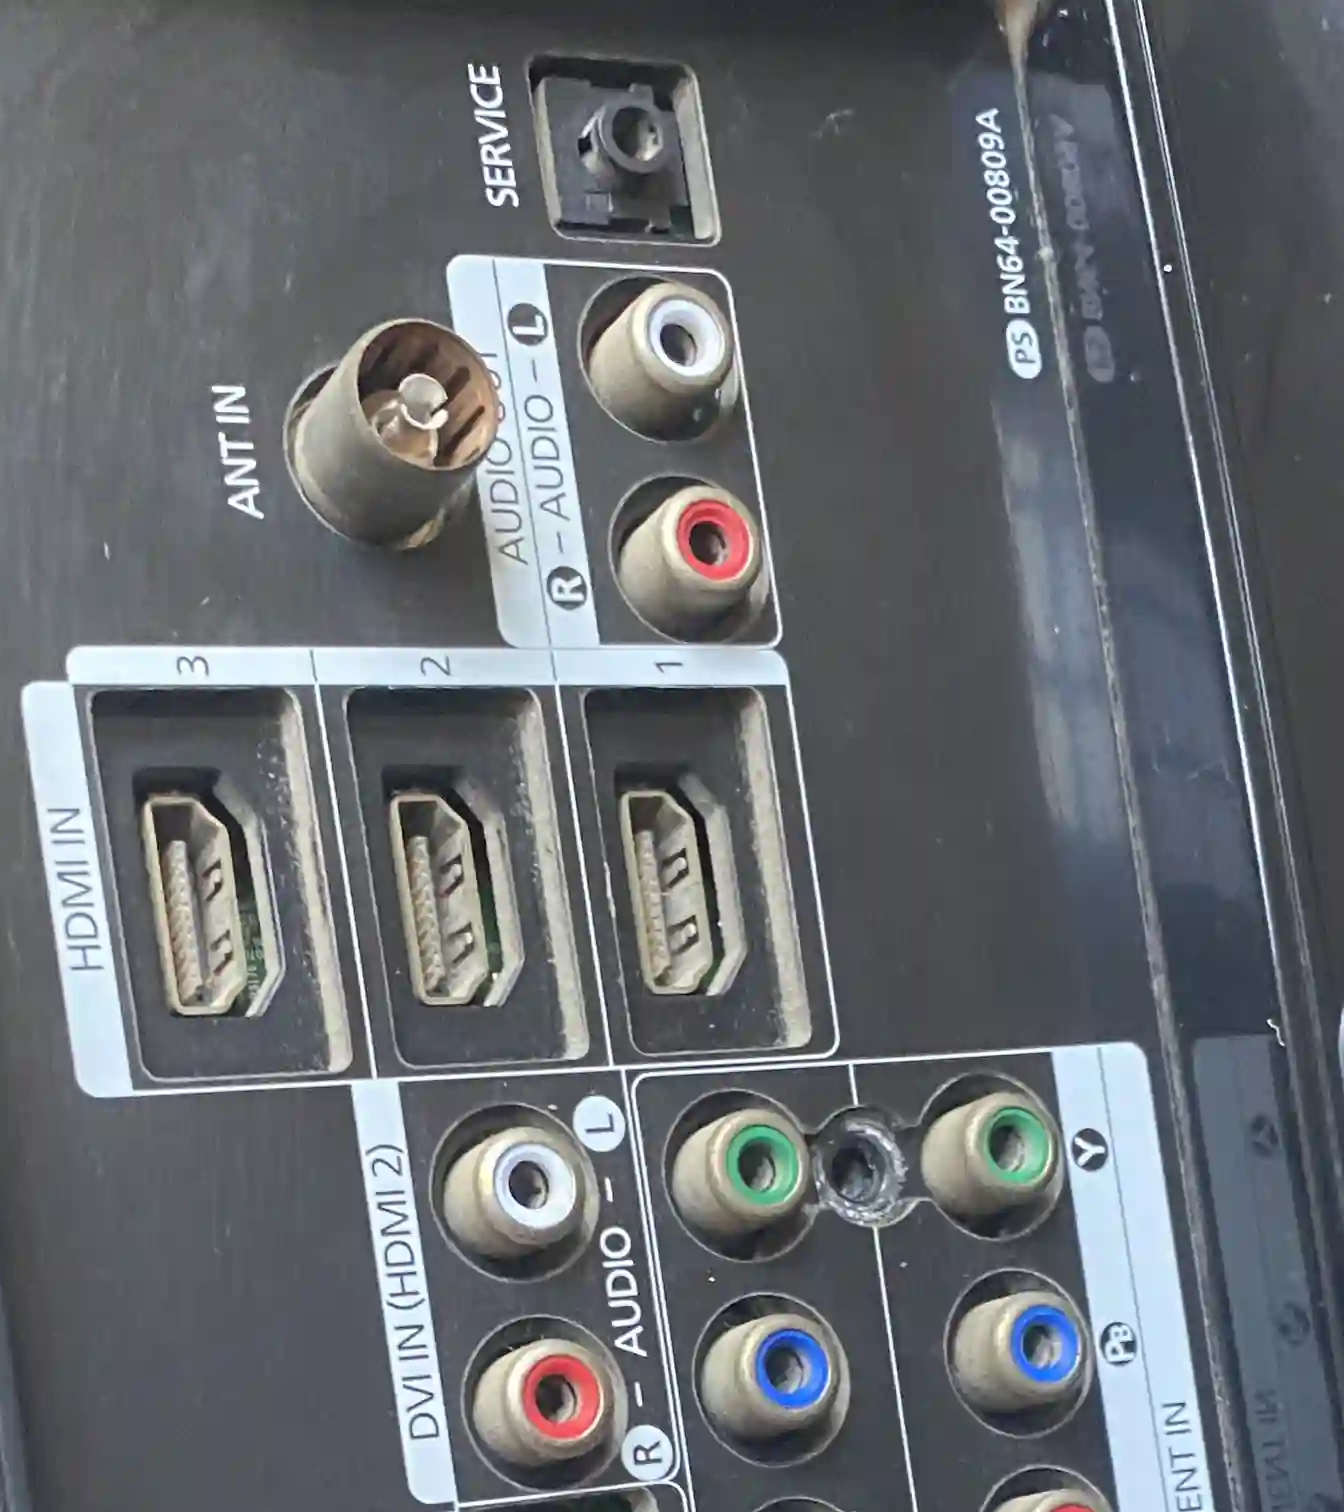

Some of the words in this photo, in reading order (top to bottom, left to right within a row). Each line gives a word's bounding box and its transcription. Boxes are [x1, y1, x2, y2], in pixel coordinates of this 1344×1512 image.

[468, 63, 519, 207] SERVICE
[975, 107, 1031, 315] BN64-00809A
[212, 385, 253, 426] IN
[218, 432, 265, 520] ANT
[523, 394, 572, 522] AUDIO
[484, 437, 529, 565] AUDIO
[177, 654, 209, 675] 3
[421, 655, 452, 676] 2
[654, 658, 683, 673] 1
[47, 807, 86, 845] IN
[55, 859, 104, 972] HDMI
[365, 1143, 404, 1178] 2)
[372, 1189, 425, 1312] (HDMI
[599, 1226, 648, 1357] AUDIO
[393, 1324, 431, 1362] IN
[399, 1374, 440, 1440] DVI
[1160, 1401, 1194, 1439] IN
